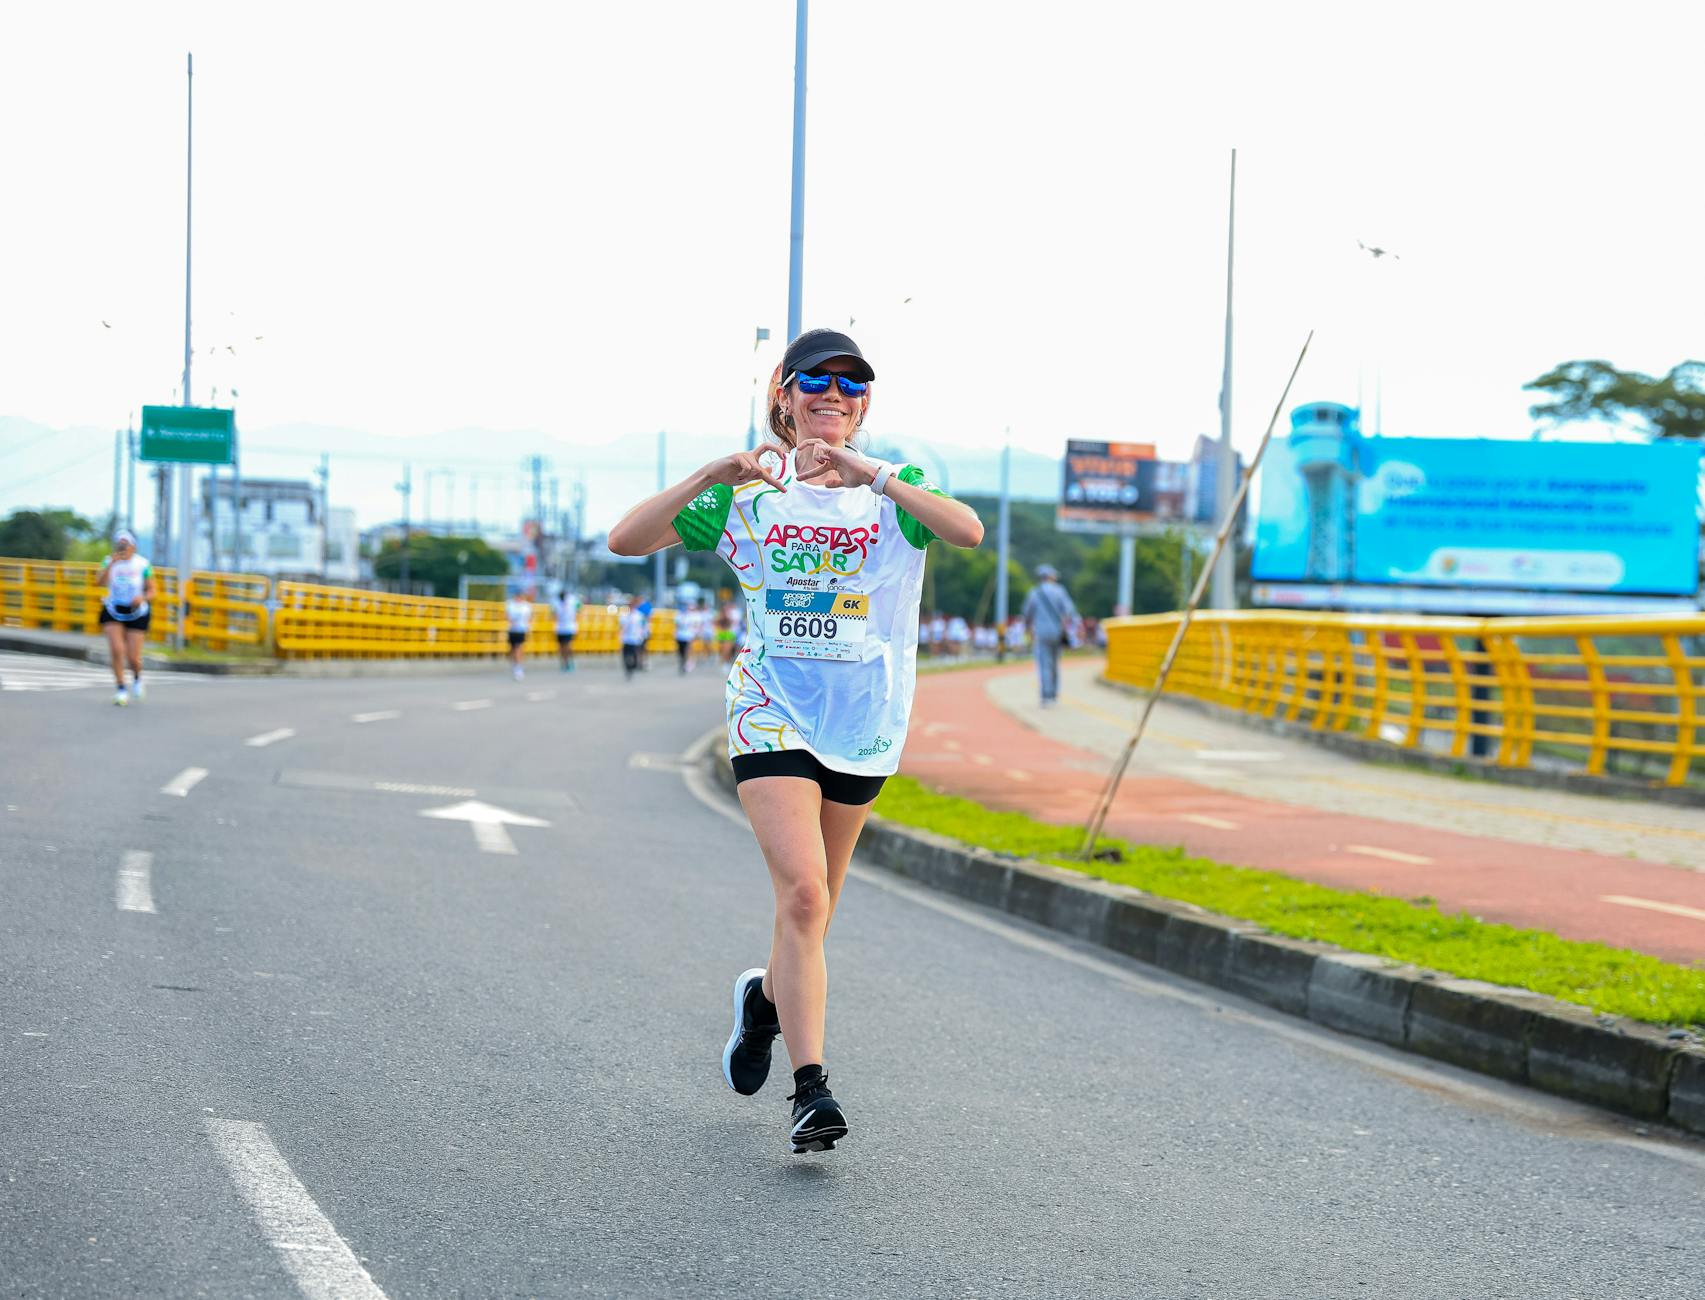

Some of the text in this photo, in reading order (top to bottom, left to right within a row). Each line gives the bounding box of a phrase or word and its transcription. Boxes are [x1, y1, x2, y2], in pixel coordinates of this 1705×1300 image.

[764, 524, 870, 558] APOSTAR
[791, 543, 820, 552] PARA
[786, 577, 820, 587] Apostar
[843, 600, 861, 609] 6K
[779, 616, 838, 639] 6609
